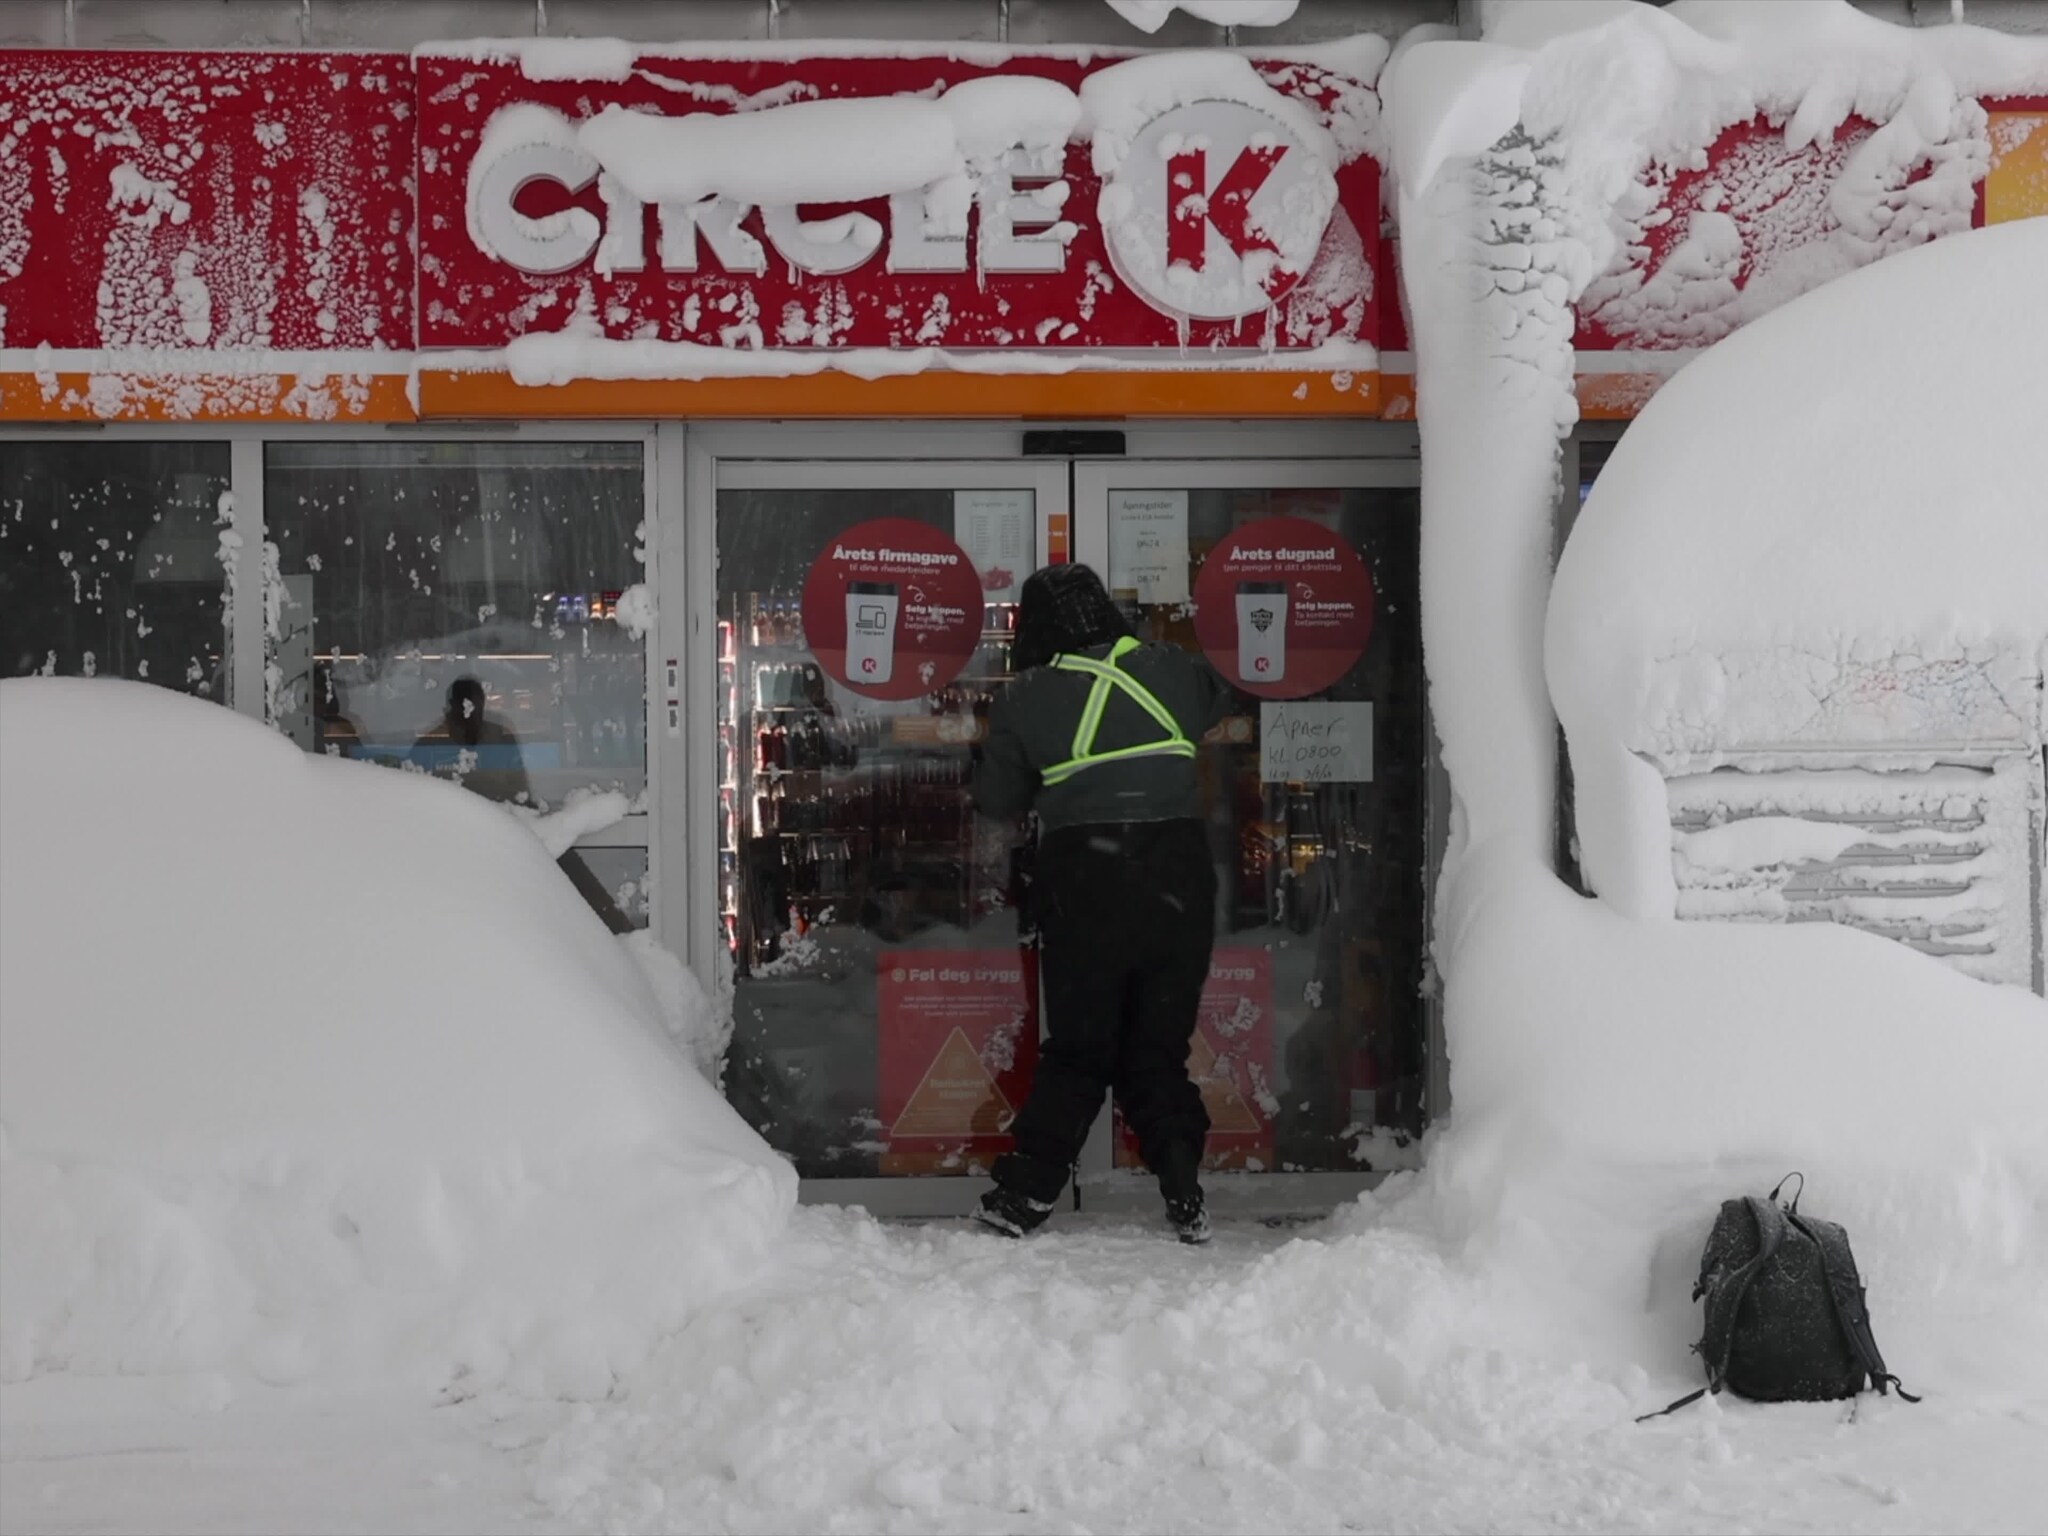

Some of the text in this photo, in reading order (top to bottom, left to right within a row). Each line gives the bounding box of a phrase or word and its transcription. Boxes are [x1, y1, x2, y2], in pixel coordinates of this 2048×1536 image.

[1166, 142, 1300, 303] K
[832, 543, 959, 566] Årets firmagave
[1229, 544, 1335, 563] Årets dugnad
[849, 562, 942, 577] til dine medarbeidere
[1223, 563, 1240, 573] tjen
[1241, 563, 1272, 573] penger
[1274, 563, 1282, 571] til
[1284, 563, 1300, 571] ditt
[904, 603, 926, 615] Selg
[1294, 602, 1355, 612] Selg koppen.
[1267, 705, 1344, 740] Åpner
[1295, 745, 1342, 762] 0800
[909, 968, 1021, 984] Føl deg trygg
[1209, 965, 1256, 981] trygg
